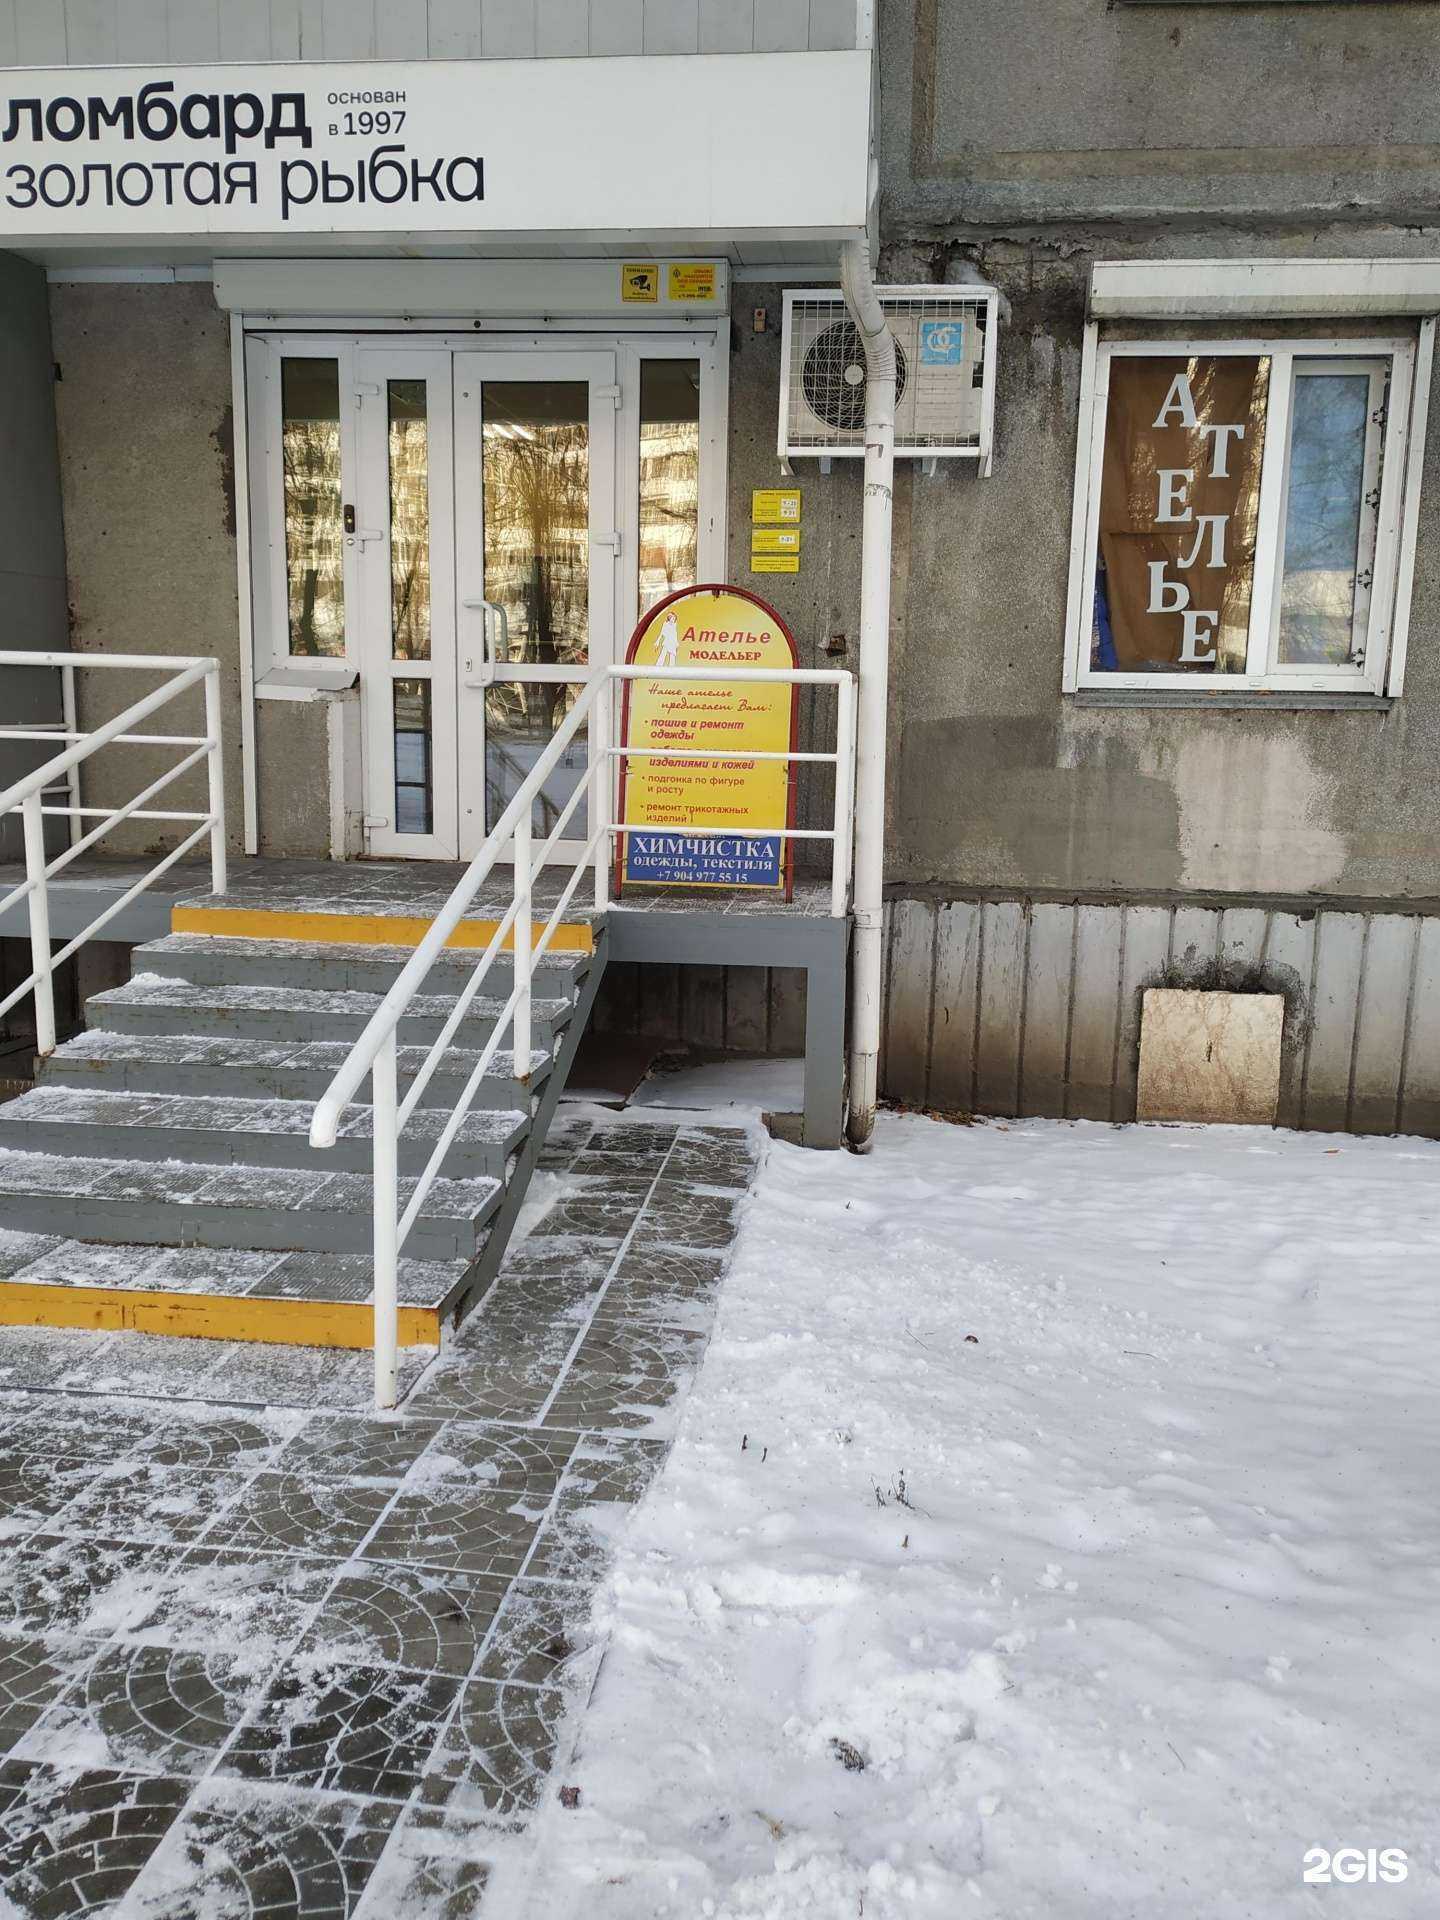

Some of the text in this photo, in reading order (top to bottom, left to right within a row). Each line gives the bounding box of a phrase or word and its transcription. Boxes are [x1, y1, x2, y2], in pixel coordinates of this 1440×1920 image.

[327, 89, 406, 105] основан
[2, 81, 312, 154] ломбард
[328, 111, 406, 136] в 1997
[5, 144, 485, 220] золотая рыбка
[682, 627, 771, 643] Ателье
[689, 650, 762, 660] МОДЕЛЬЕР
[649, 683, 734, 697] Наше ателье
[661, 697, 772, 714] предлагает Вам:
[651, 719, 745, 730] пошив и ремонт
[650, 730, 695, 740] одежды
[649, 757, 708, 768] изделиями
[722, 760, 755, 770] кожей
[648, 775, 692, 784] подгонка
[710, 776, 745, 787] фигуре
[647, 785, 684, 796] и росту
[646, 803, 750, 815] ремонт трикотажных
[646, 813, 688, 823] изделий
[633, 837, 774, 857] ХИМЧИСТКА
[633, 855, 772, 870] одежды, текстиля
[656, 871, 748, 883] +7 904 977 55 15
